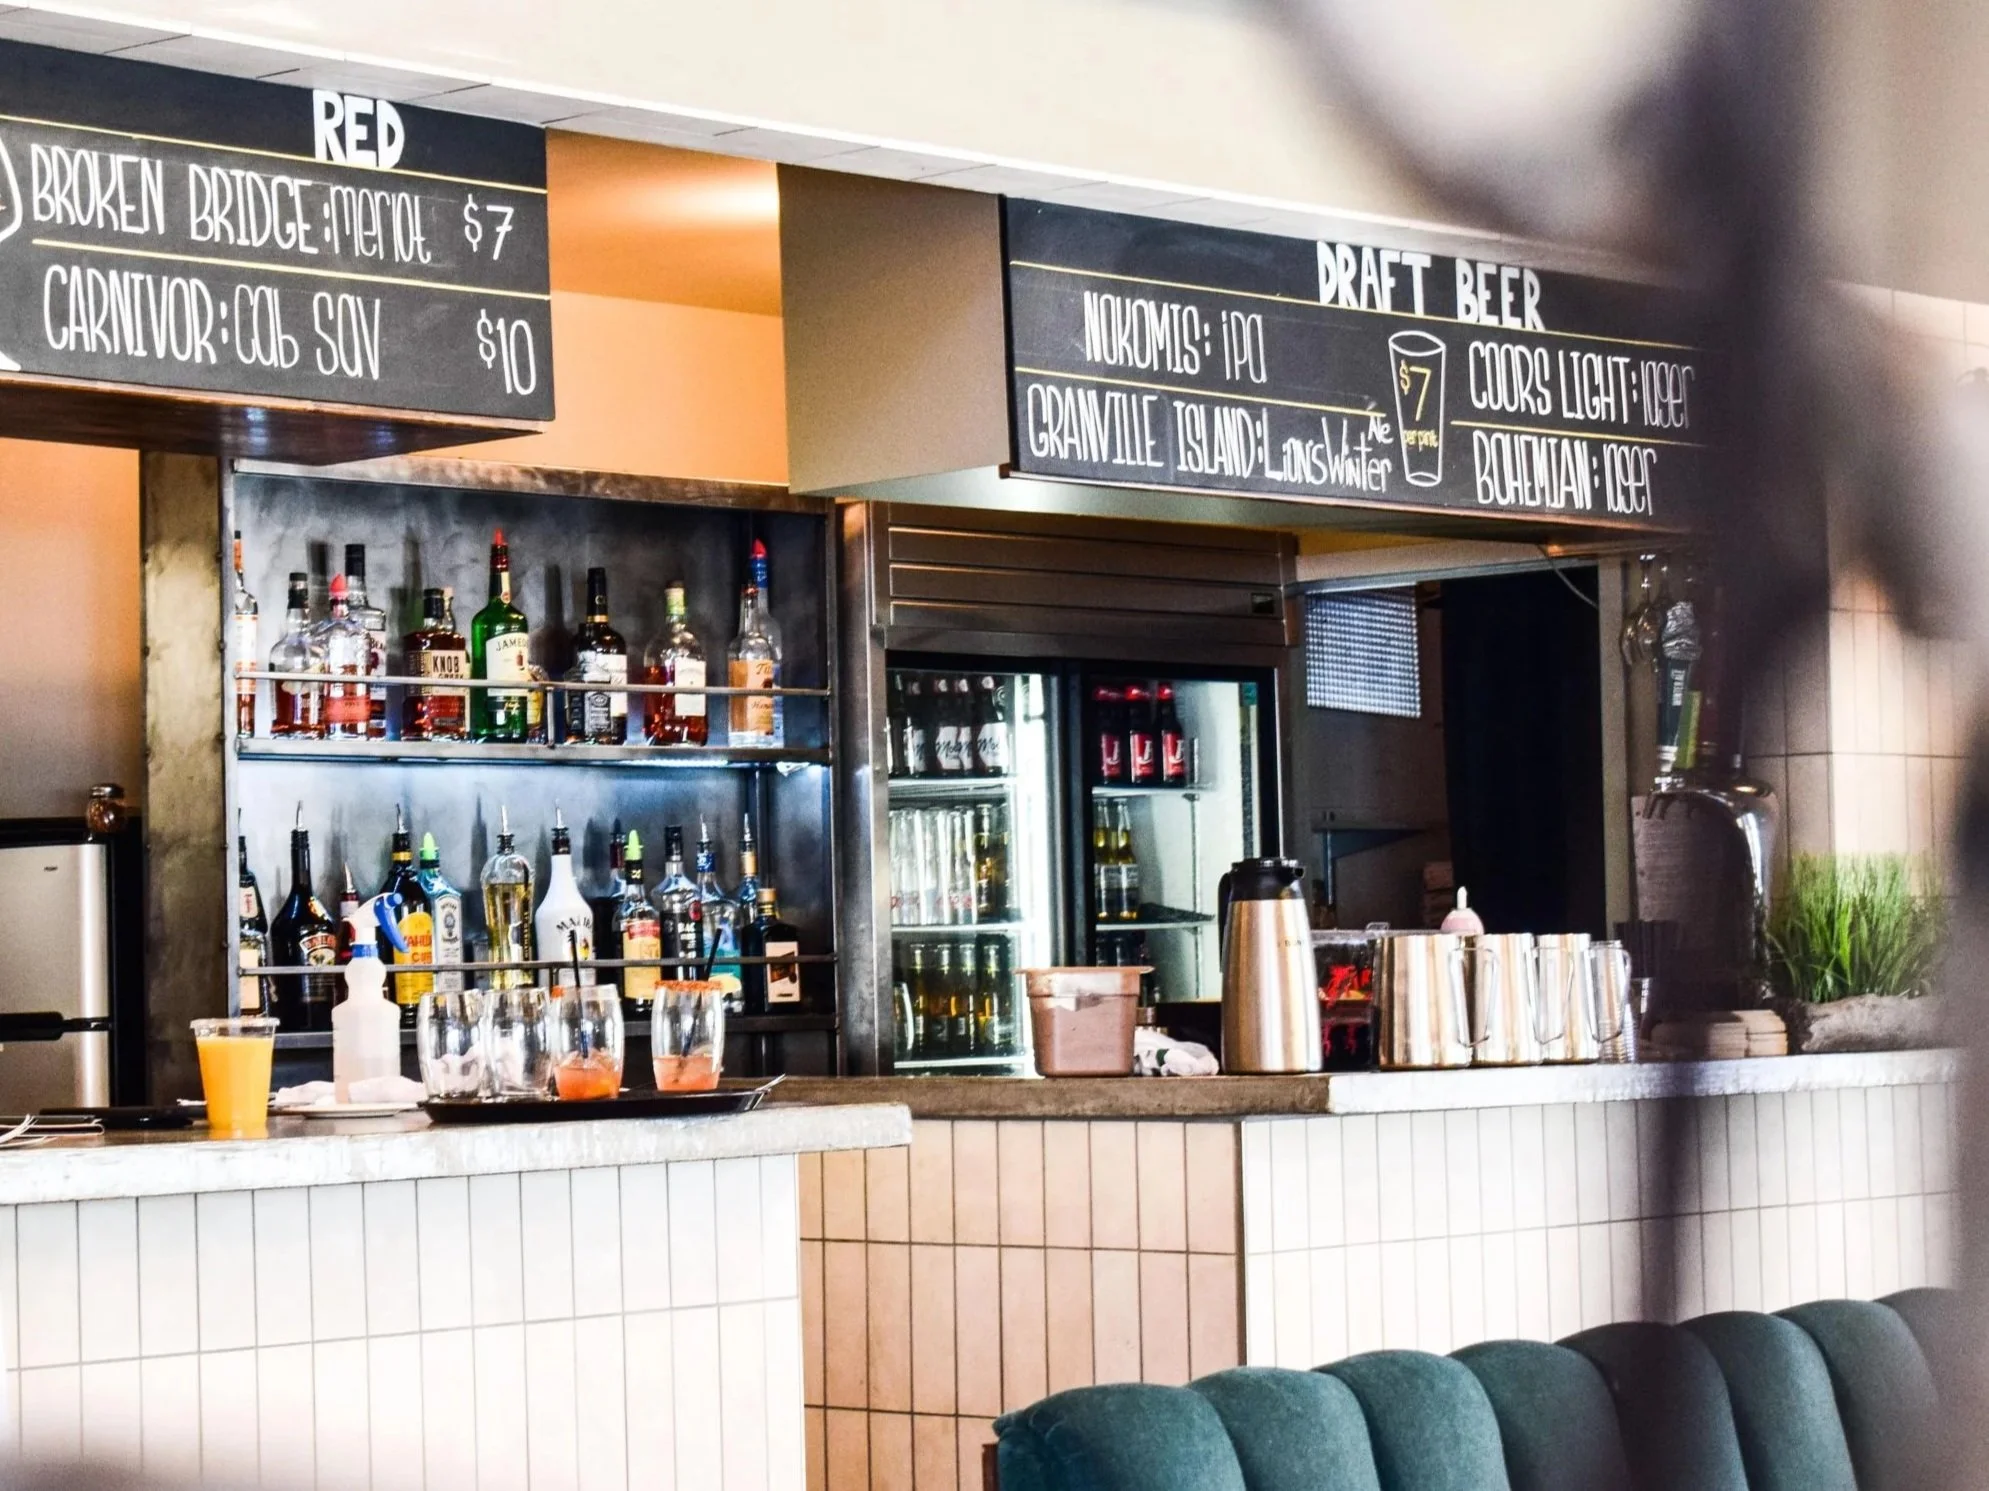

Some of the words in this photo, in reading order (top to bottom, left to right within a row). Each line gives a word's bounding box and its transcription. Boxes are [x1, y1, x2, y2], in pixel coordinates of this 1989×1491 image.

[313, 90, 404, 169] RED
[31, 143, 164, 235] BROKEN
[464, 193, 514, 260] $7
[1317, 240, 1431, 316] DRAFT
[1456, 257, 1546, 331] BEER
[476, 308, 536, 395] $10
[1399, 359, 1431, 421] $7
[1468, 341, 1551, 415] COORS
[1027, 382, 1164, 467] GRANVILLE
[1367, 416, 1394, 444] Ale
[432, 655, 460, 673] KNOB
